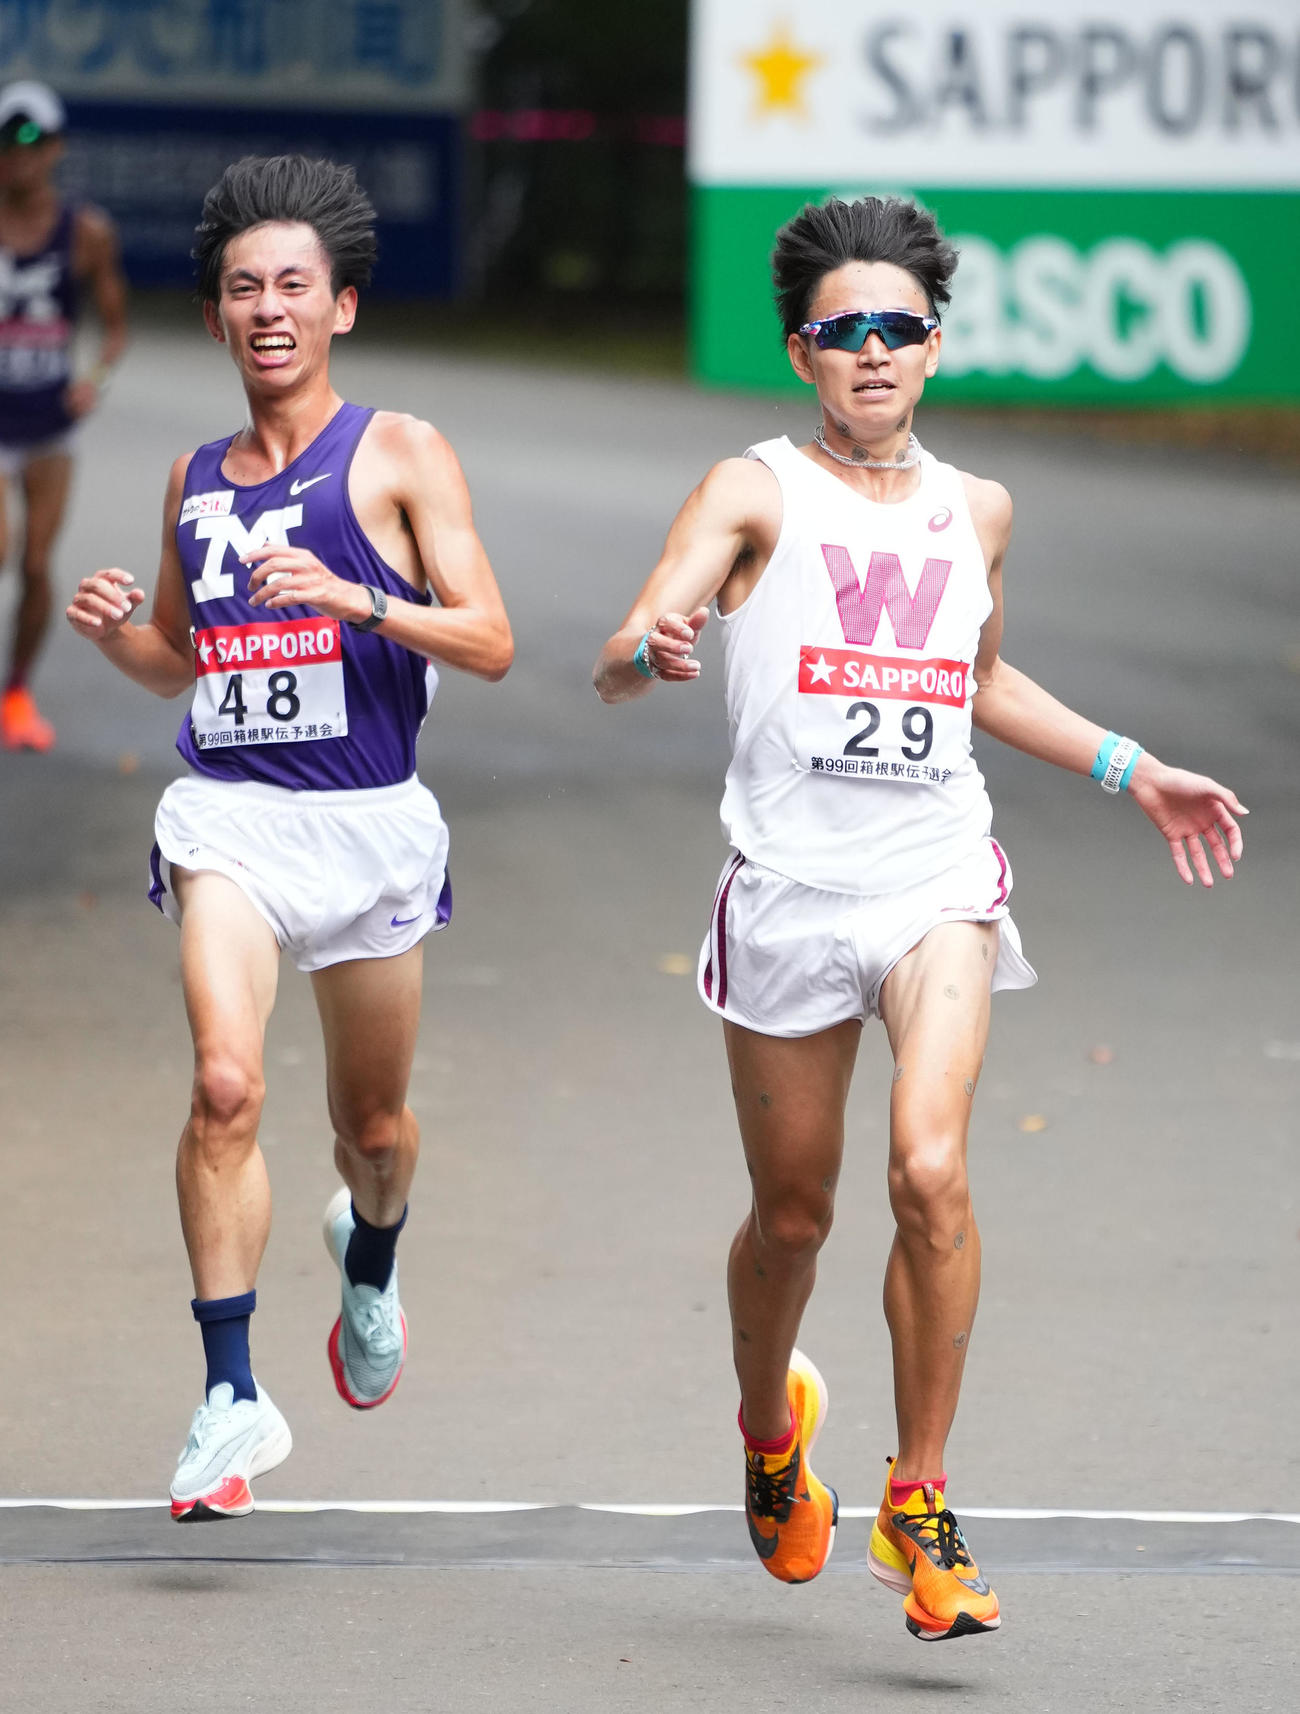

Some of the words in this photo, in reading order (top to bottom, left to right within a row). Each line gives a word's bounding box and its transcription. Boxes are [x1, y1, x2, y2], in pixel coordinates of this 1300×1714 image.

[860, 22, 1300, 138] SAPPOR
[905, 190, 1251, 383] asco
[191, 503, 303, 604] M
[820, 543, 953, 650] W
[214, 627, 334, 664] SAPPORO
[218, 670, 301, 727] 48
[843, 660, 963, 699] SAPPORO
[198, 722, 333, 747] 第99回箱根駅伝予選会
[843, 701, 934, 762] 29
